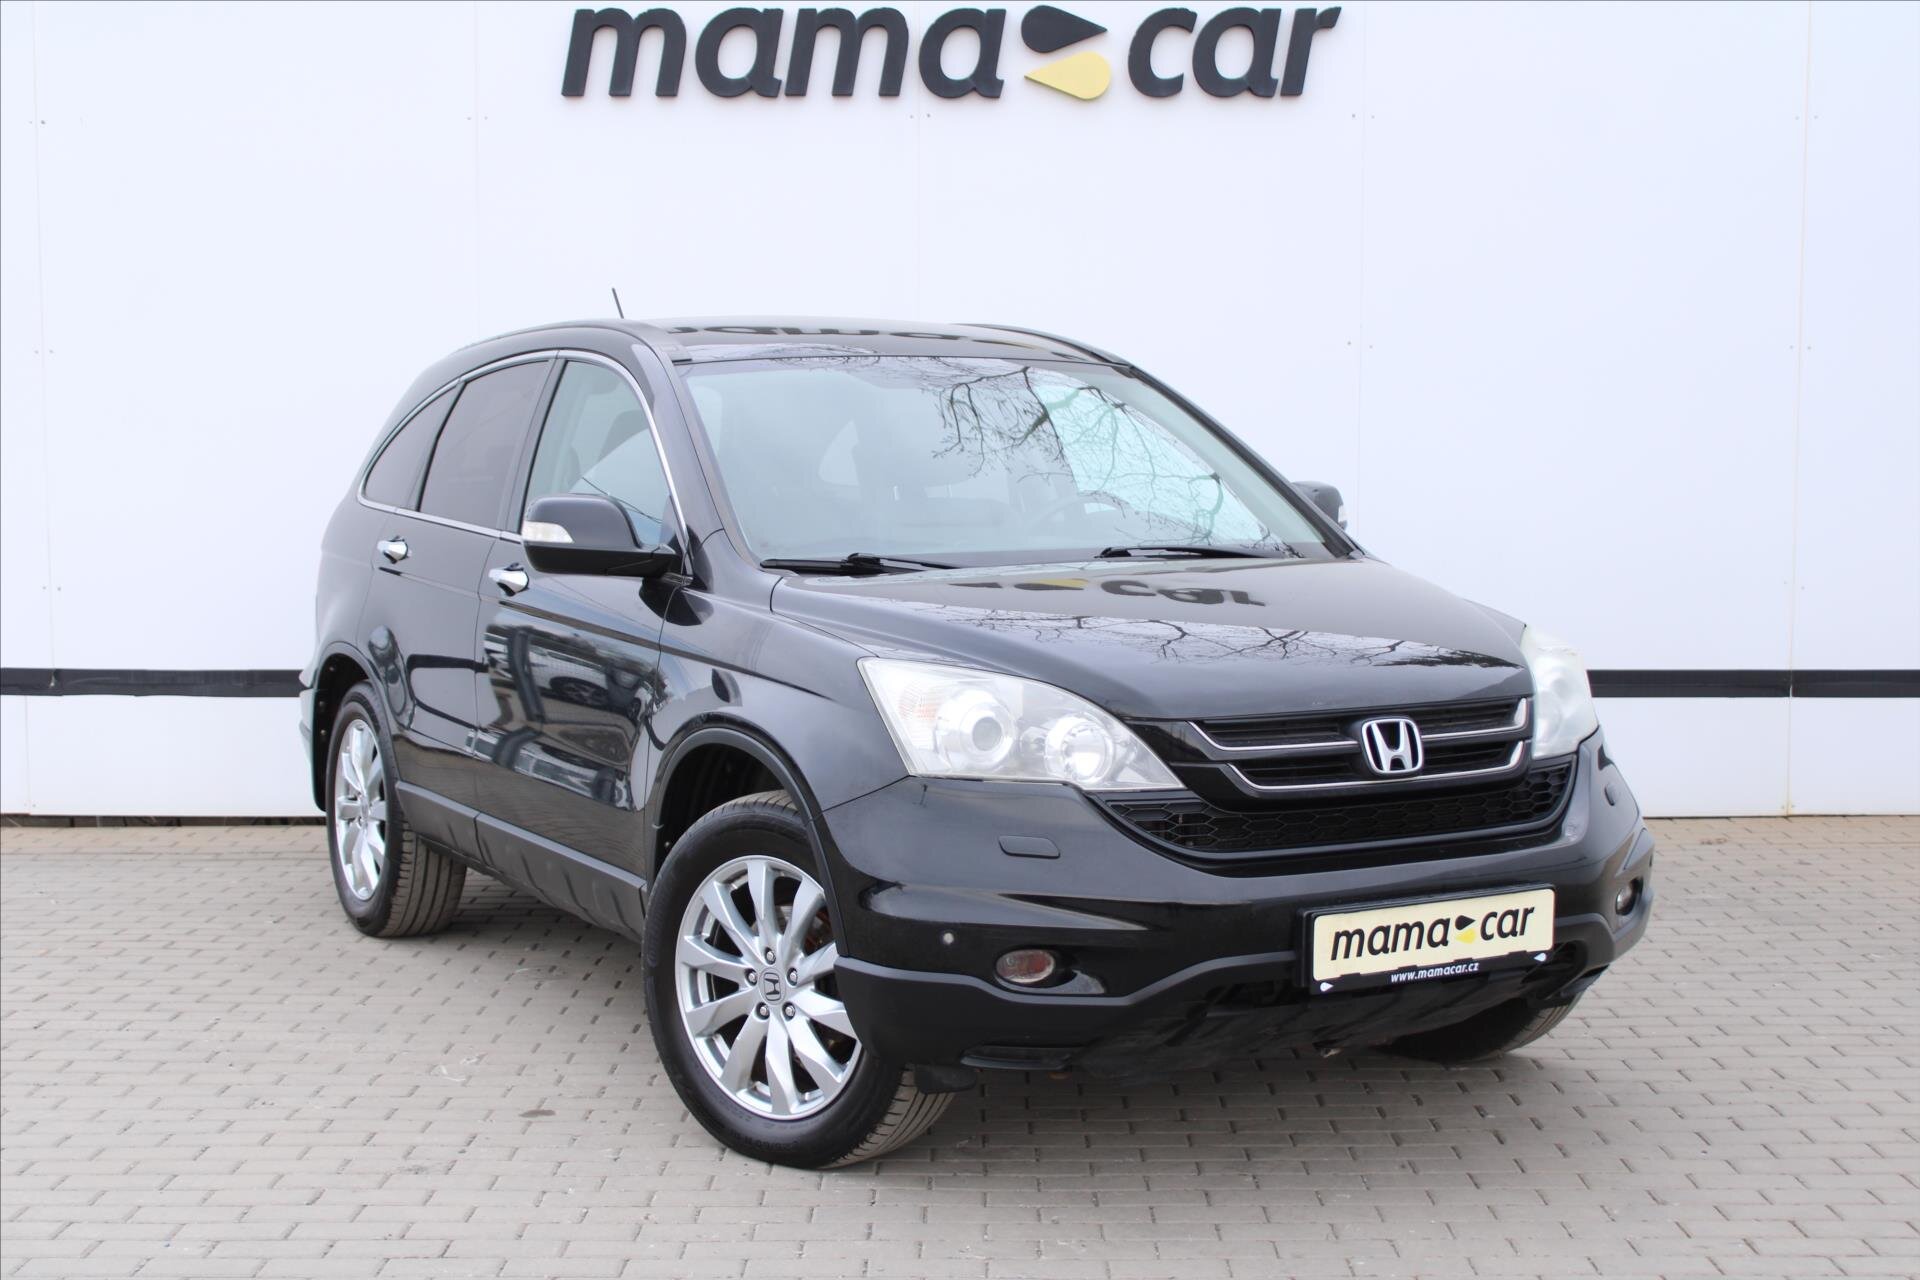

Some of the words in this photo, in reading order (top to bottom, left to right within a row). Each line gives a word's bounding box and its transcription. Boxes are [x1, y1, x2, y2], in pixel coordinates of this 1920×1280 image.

[561, 7, 1006, 100] mama
[1128, 7, 1342, 99] car
[1330, 917, 1451, 961] mama
[1480, 906, 1535, 941] car
[1390, 961, 1480, 983] www.mamacar.cz
